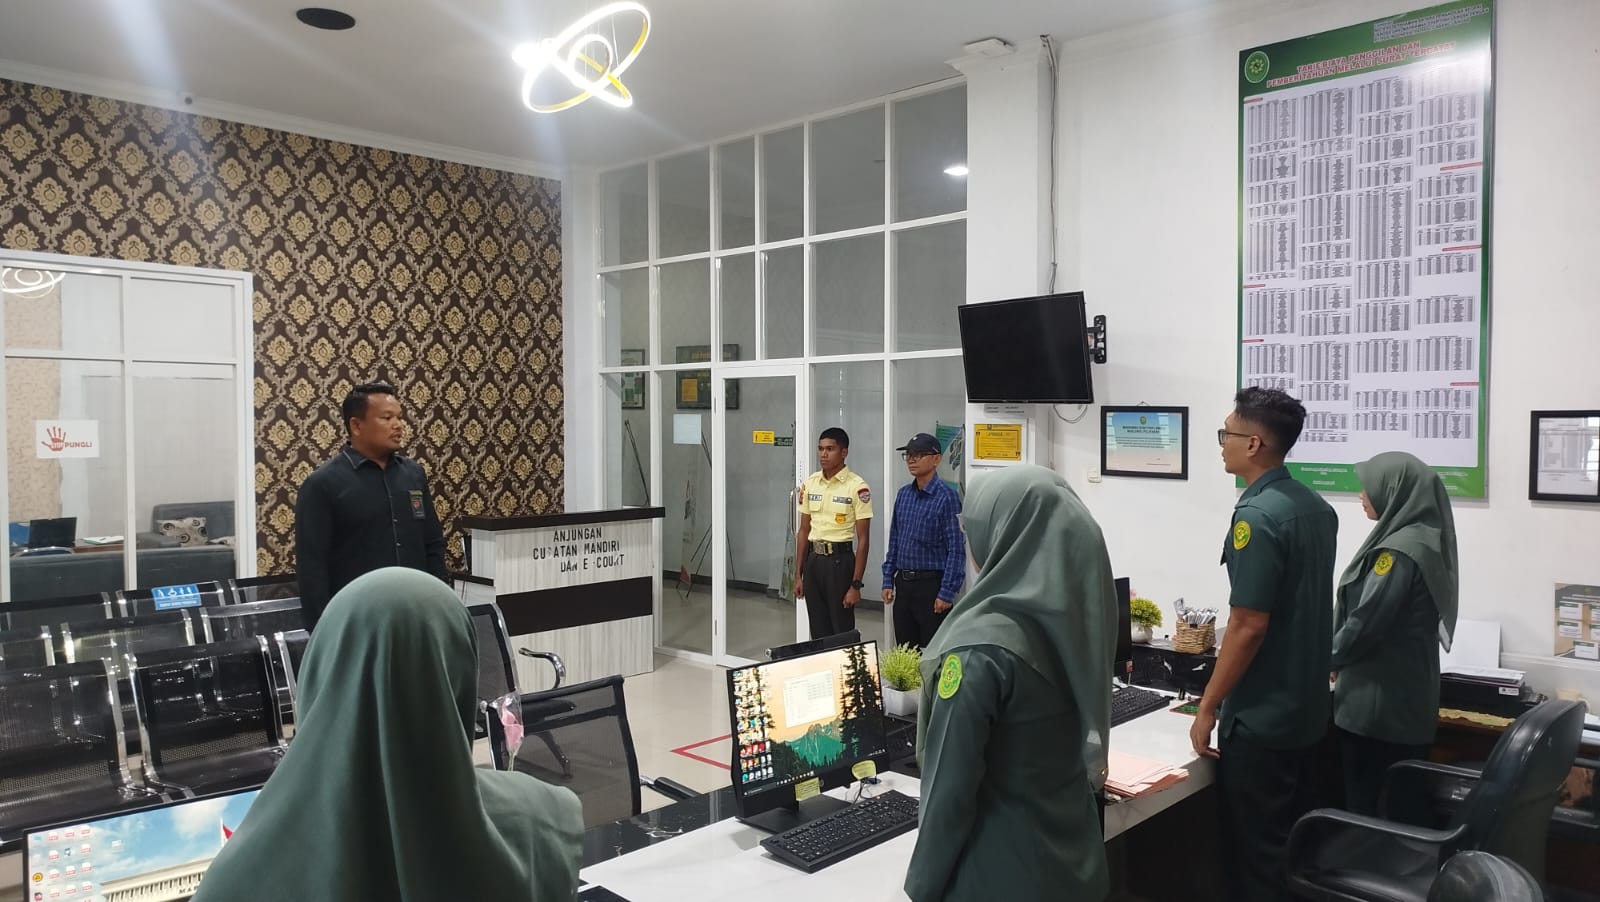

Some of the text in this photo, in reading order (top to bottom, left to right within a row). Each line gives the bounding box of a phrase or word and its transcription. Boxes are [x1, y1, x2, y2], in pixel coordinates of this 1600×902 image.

[1349, 45, 1399, 61] PANGGILAN
[1402, 40, 1420, 51] DAN
[1266, 67, 1335, 88] PEMBERITAHUAN
[1376, 53, 1406, 67] SURAT
[553, 527, 602, 542] ANJUNGAN
[583, 540, 620, 554] MANDIRI
